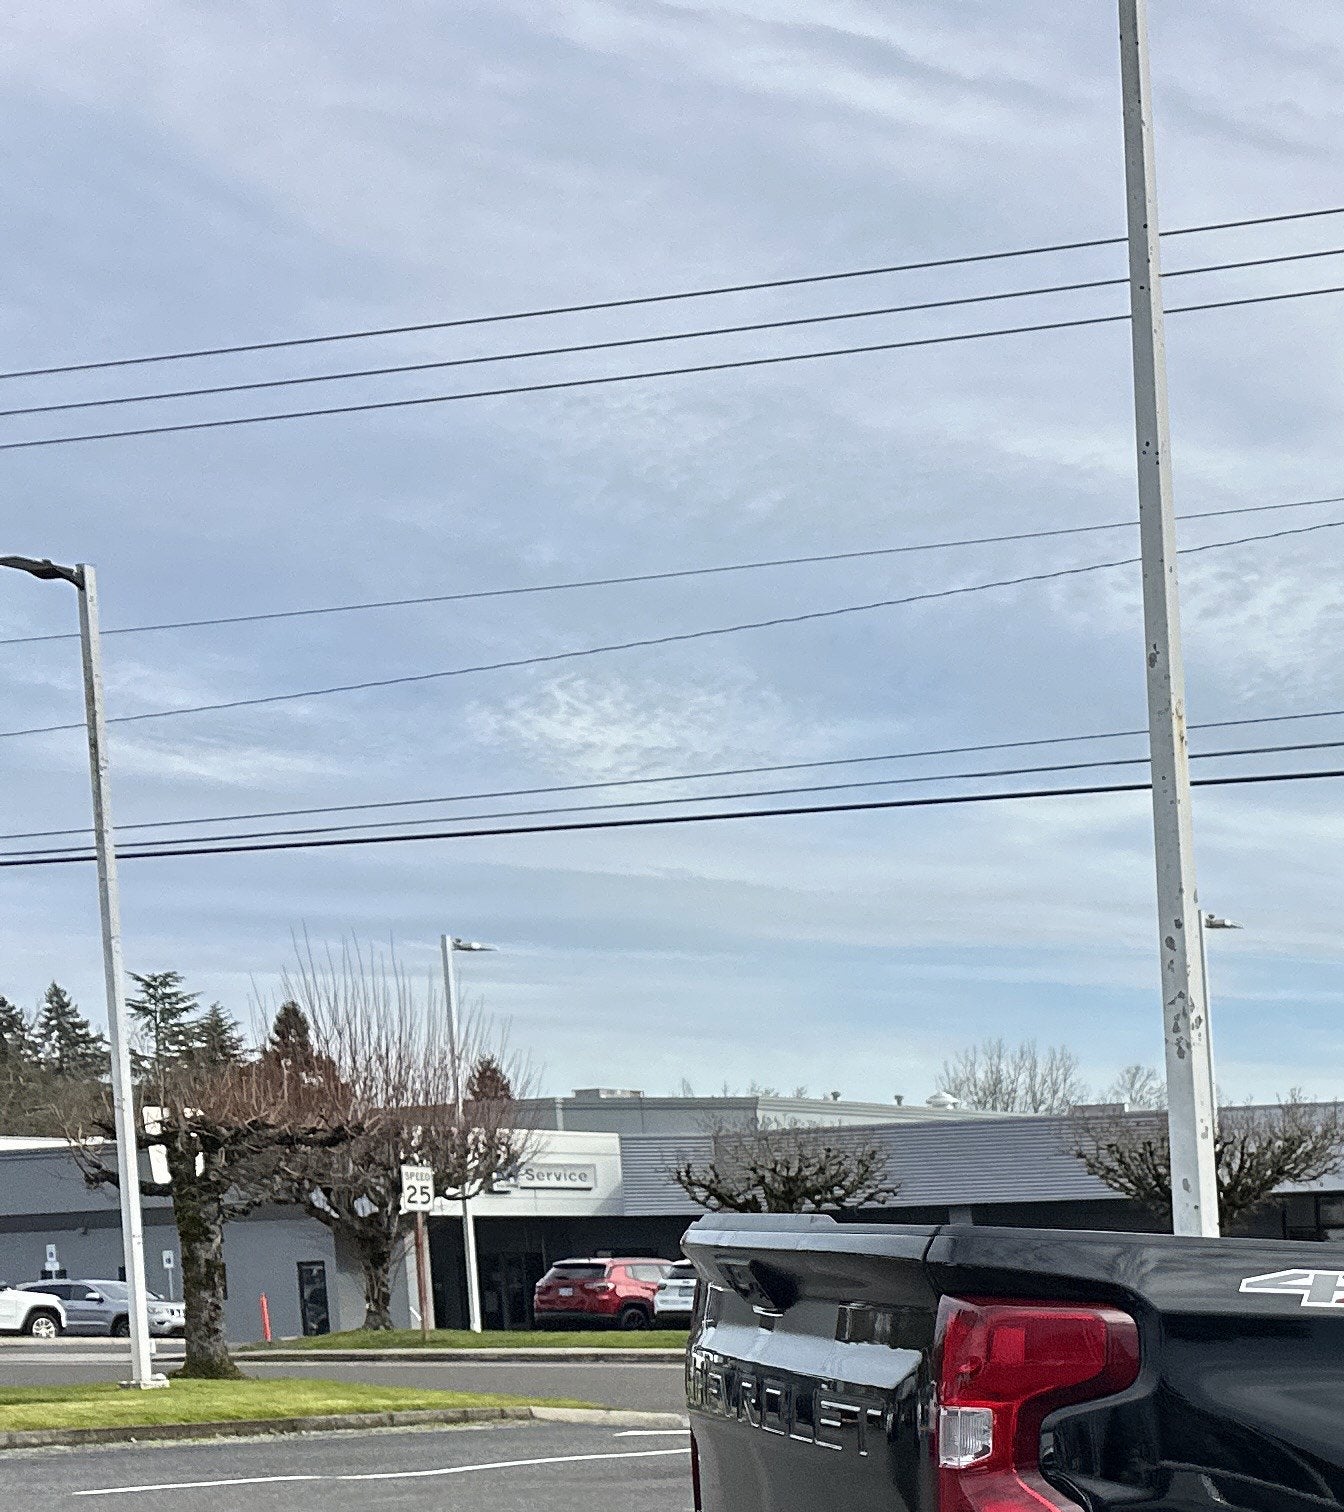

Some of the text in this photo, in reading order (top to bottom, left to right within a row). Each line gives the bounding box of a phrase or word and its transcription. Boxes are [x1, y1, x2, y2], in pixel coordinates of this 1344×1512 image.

[404, 1171, 432, 1182] SPEED
[525, 1168, 588, 1182] Service
[406, 1185, 432, 1204] 25
